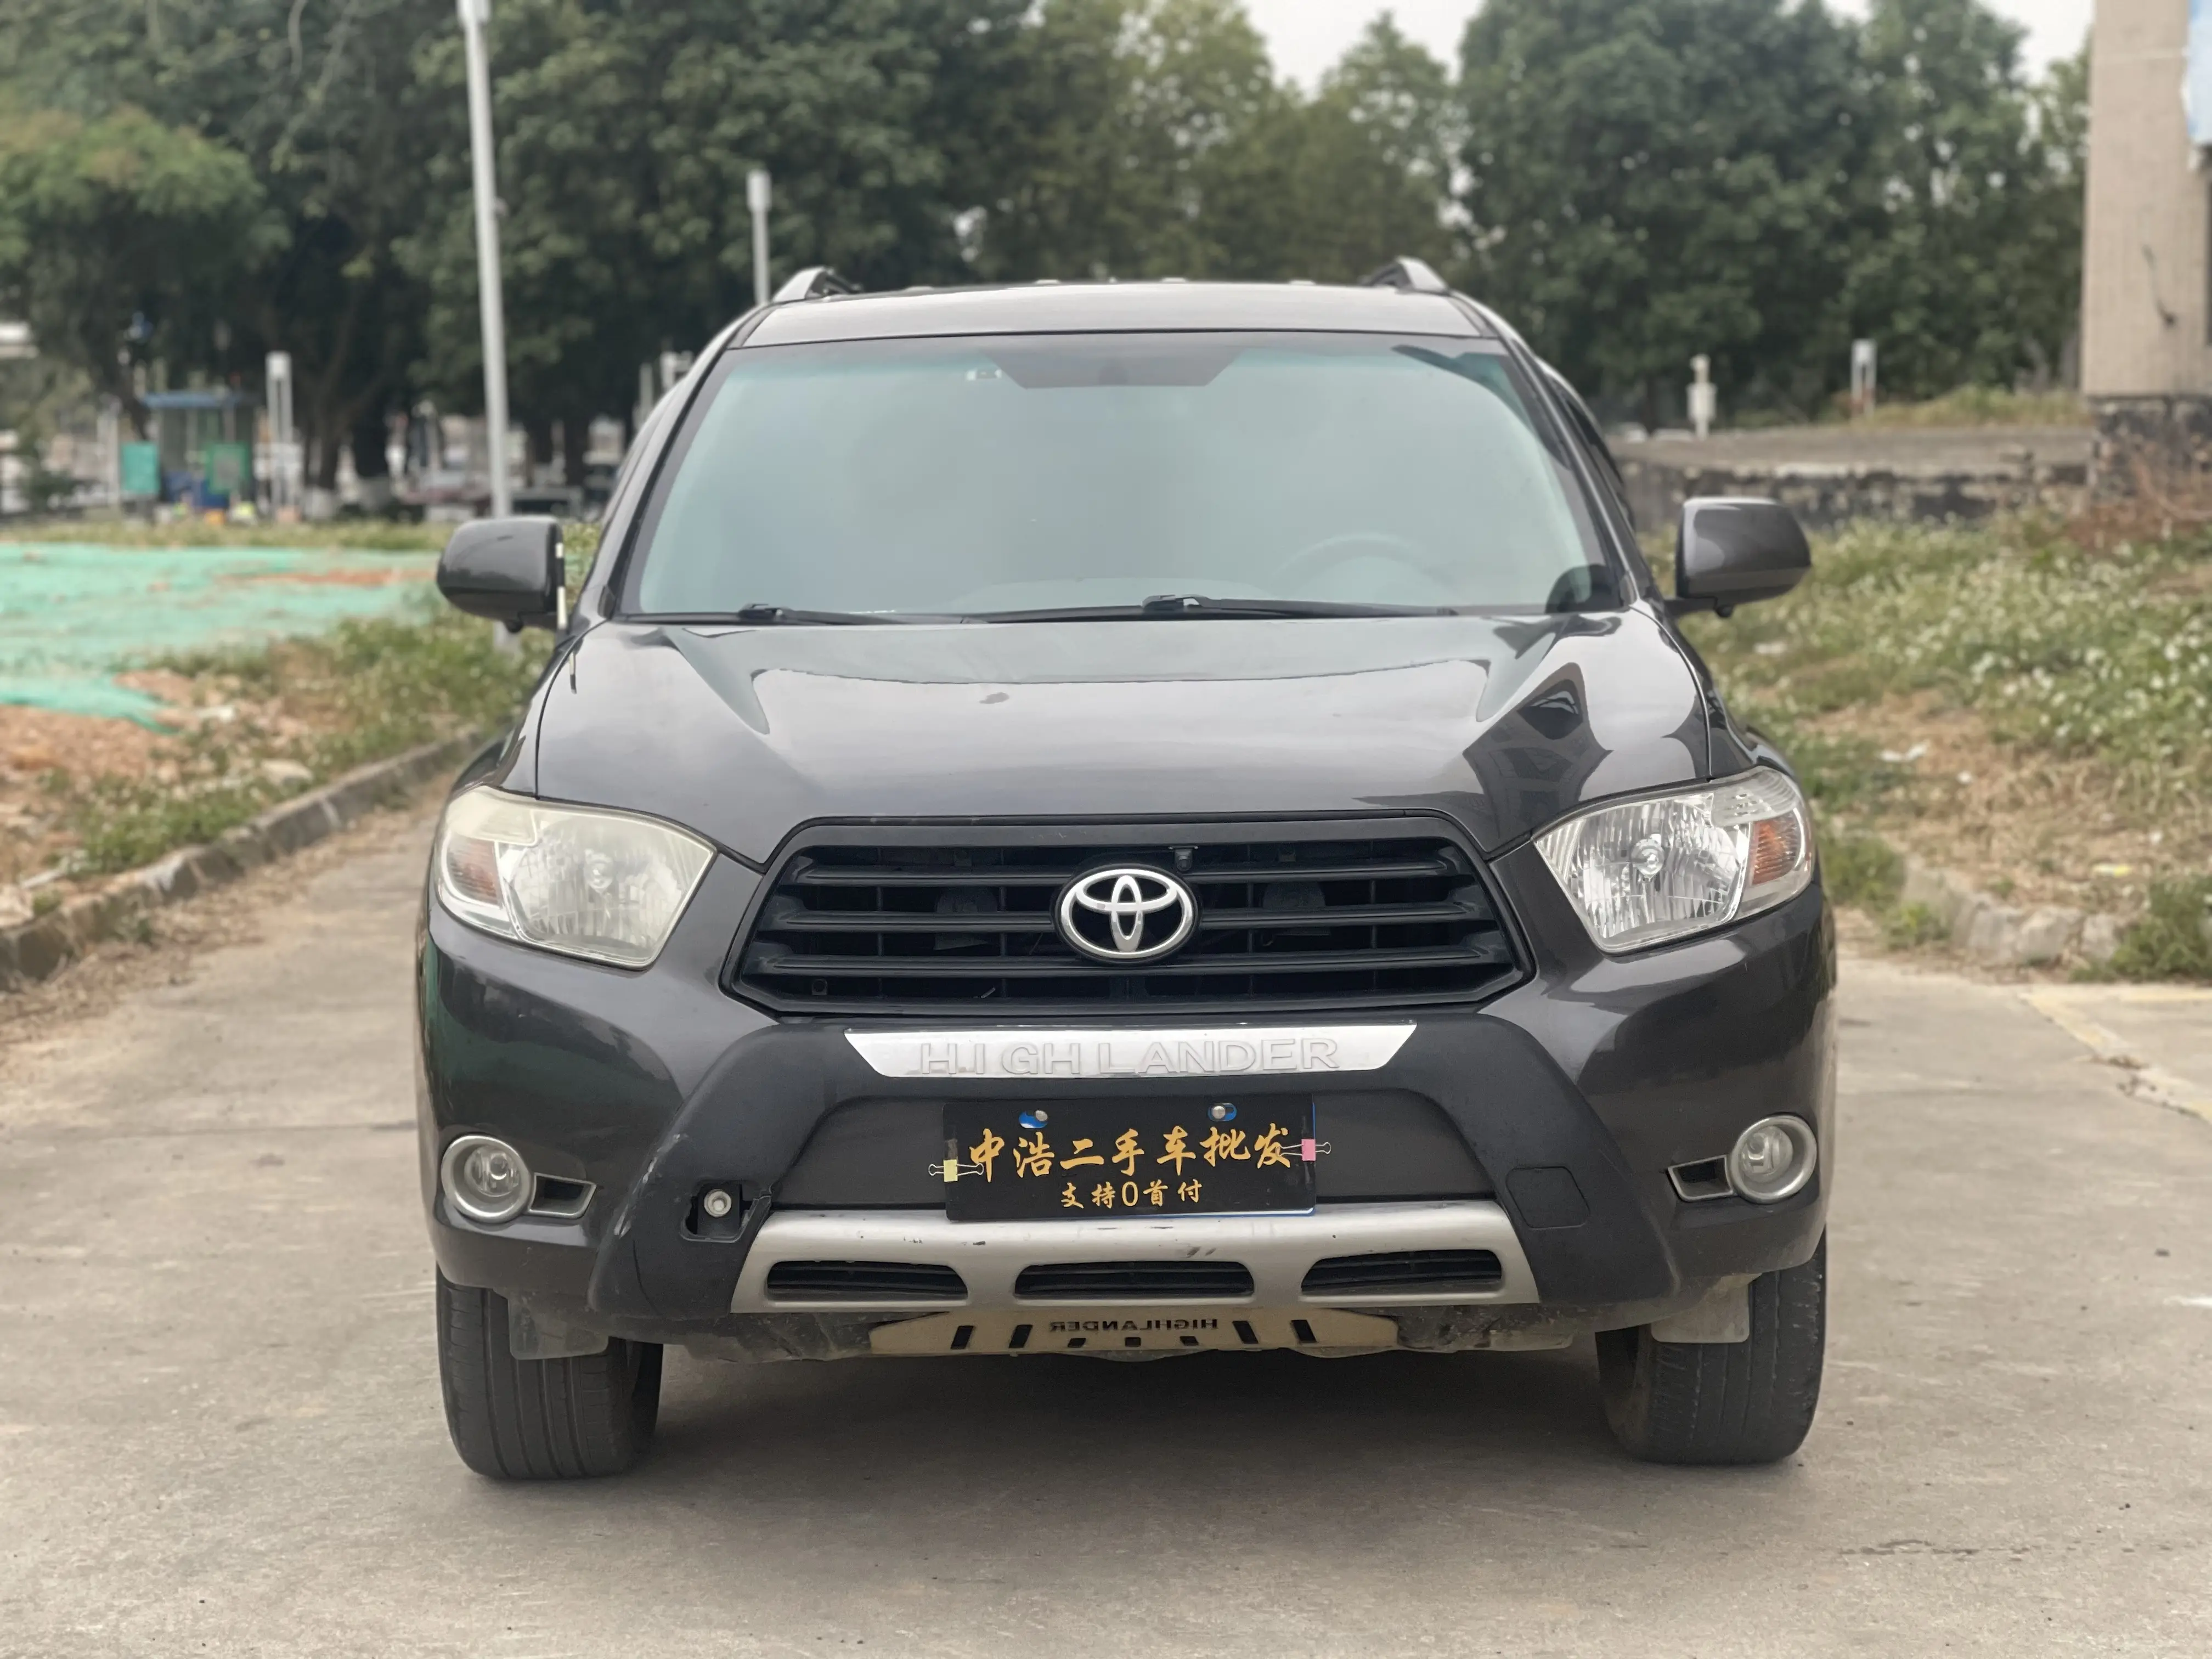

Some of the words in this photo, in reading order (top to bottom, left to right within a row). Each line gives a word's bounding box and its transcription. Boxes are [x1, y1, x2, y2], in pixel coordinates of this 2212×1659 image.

[921, 1038, 1340, 1075] HIGHLANDER
[969, 1123, 1291, 1183] 中浩二手车批发
[1060, 1178, 1203, 1209] 支持0首付
